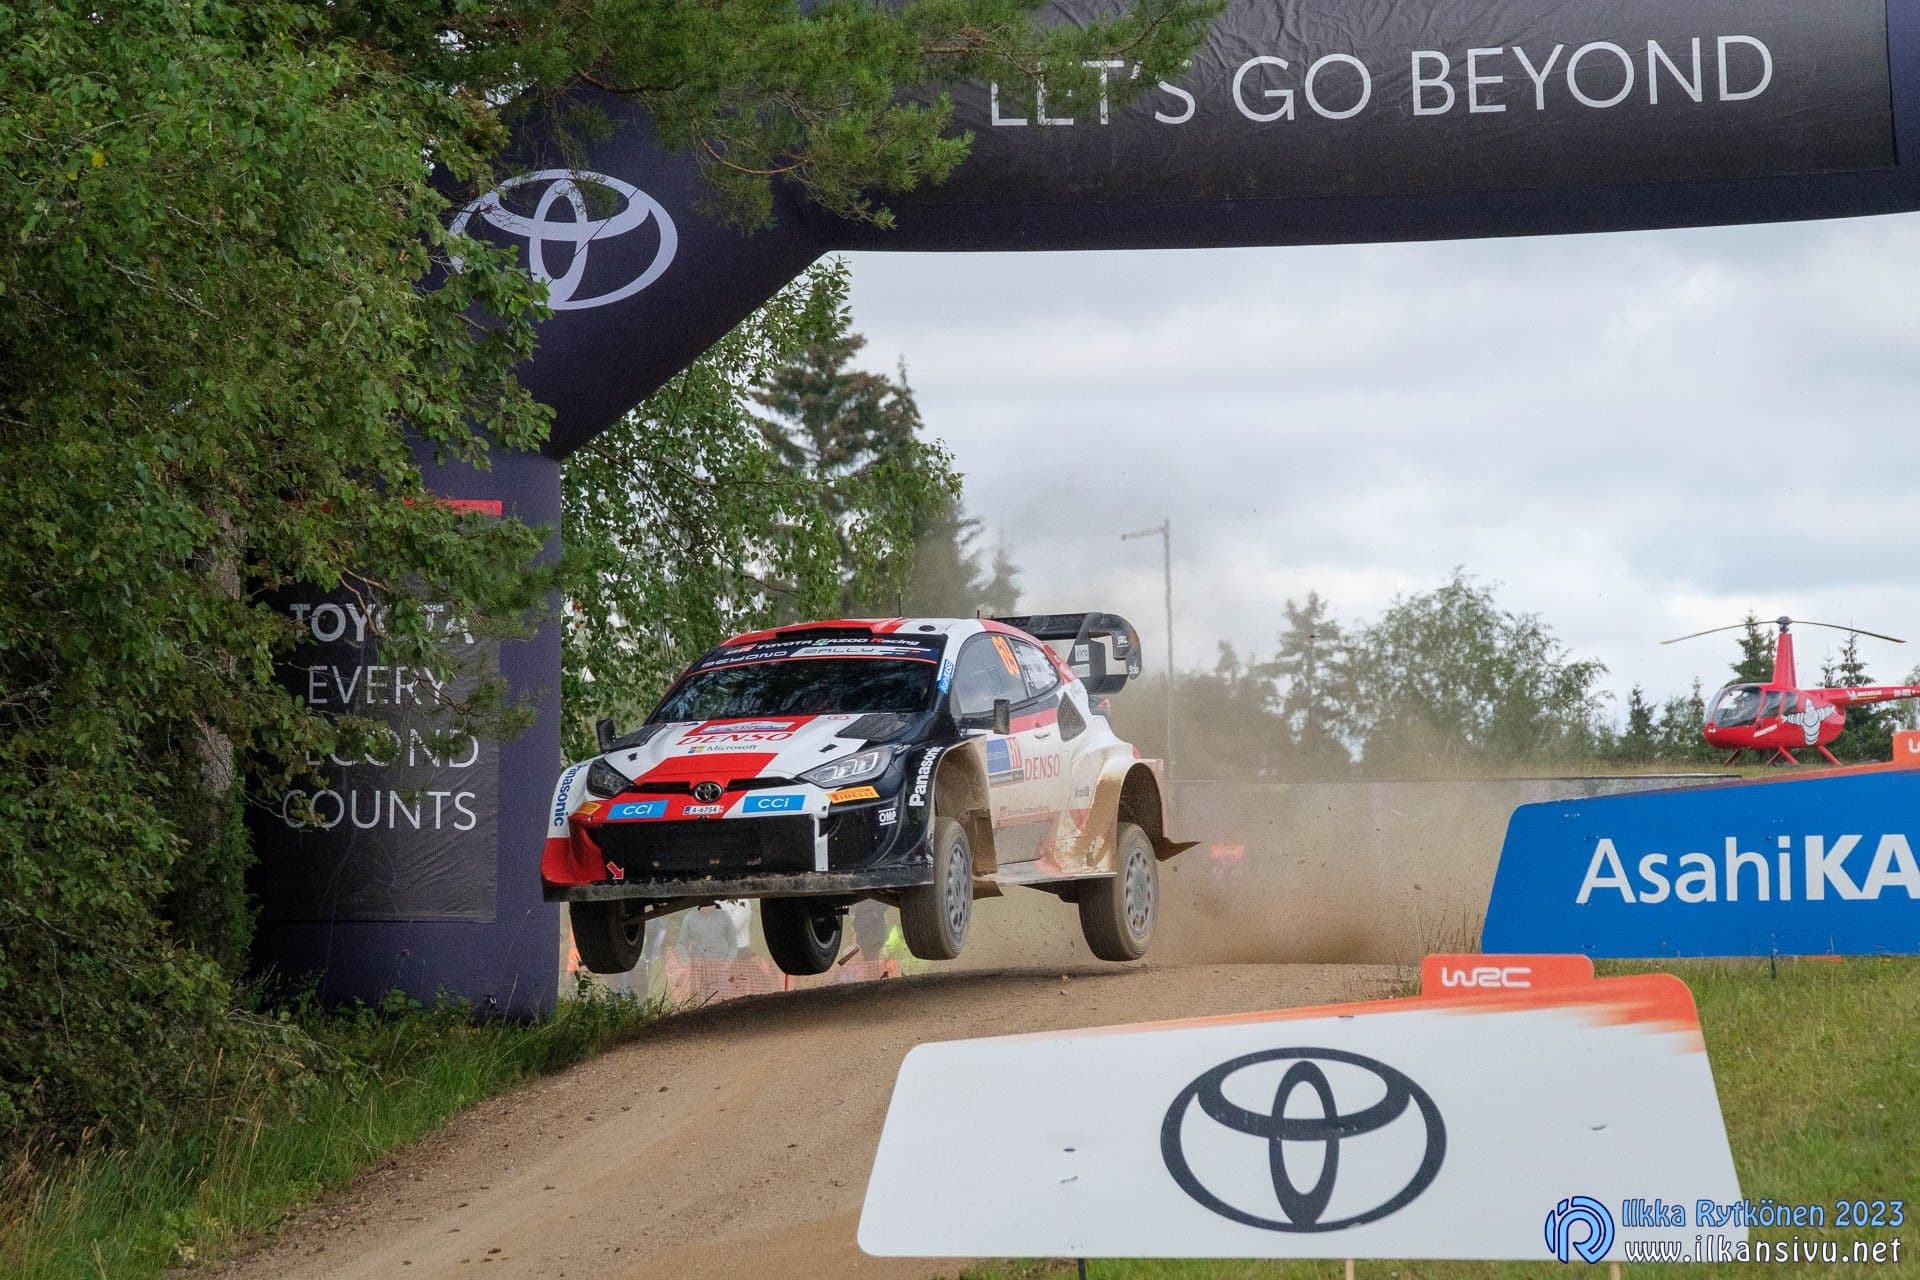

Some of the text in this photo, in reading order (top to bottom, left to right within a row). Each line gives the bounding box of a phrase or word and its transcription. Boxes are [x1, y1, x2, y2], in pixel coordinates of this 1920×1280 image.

[1232, 53, 1372, 122] GO
[1411, 34, 1773, 116] BEYOND
[757, 640, 812, 650] TOYOTA
[812, 638, 868, 646] GAZOO
[870, 638, 920, 646] Racing
[701, 650, 788, 668] BEYOND
[308, 665, 444, 705] EVERY
[676, 732, 793, 746] DENSO
[707, 744, 757, 752] Microsoft
[1024, 753, 1061, 781] DENSO
[282, 790, 478, 831] COUNTS
[879, 810, 897, 823] OMP
[1442, 966, 1532, 988] WRC
